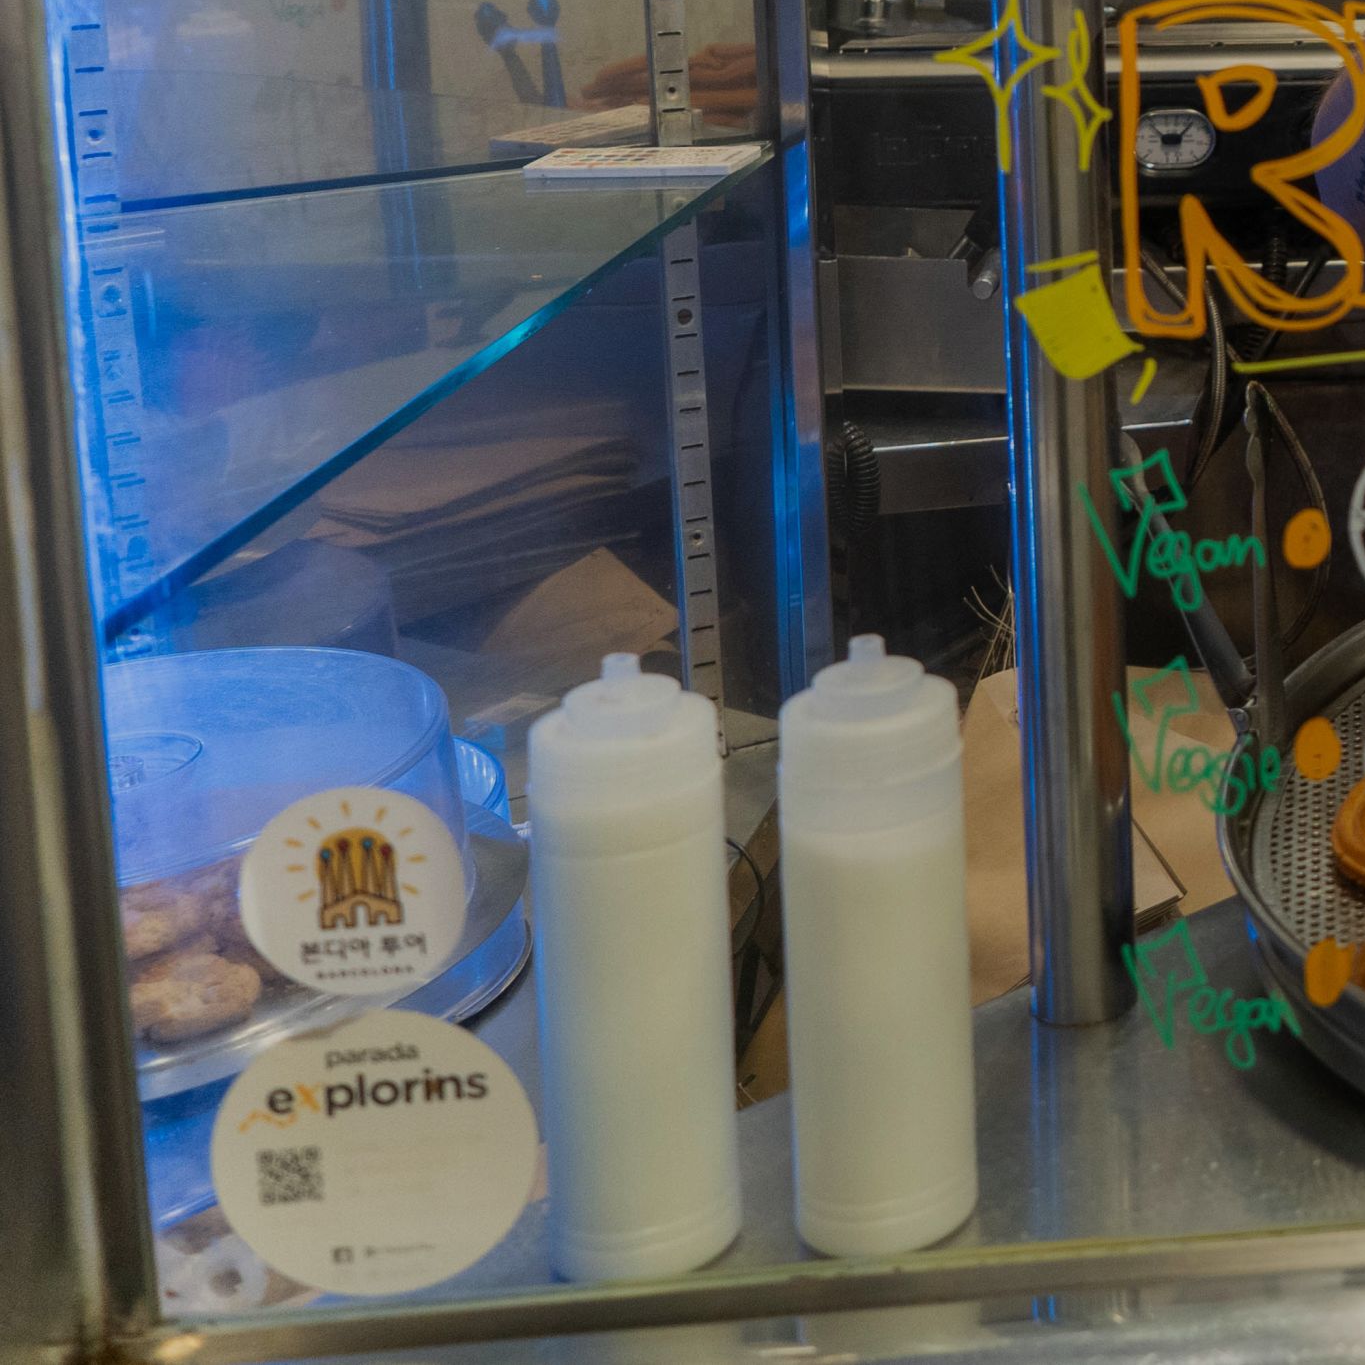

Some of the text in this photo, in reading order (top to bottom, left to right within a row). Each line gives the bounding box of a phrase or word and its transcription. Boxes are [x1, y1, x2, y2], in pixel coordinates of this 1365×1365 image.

[1078, 476, 1267, 612] Vegan
[1112, 686, 1282, 816] Veggie
[325, 1043, 421, 1070] parada
[1121, 937, 1301, 1070] Vegan
[267, 1067, 489, 1117] explorins
